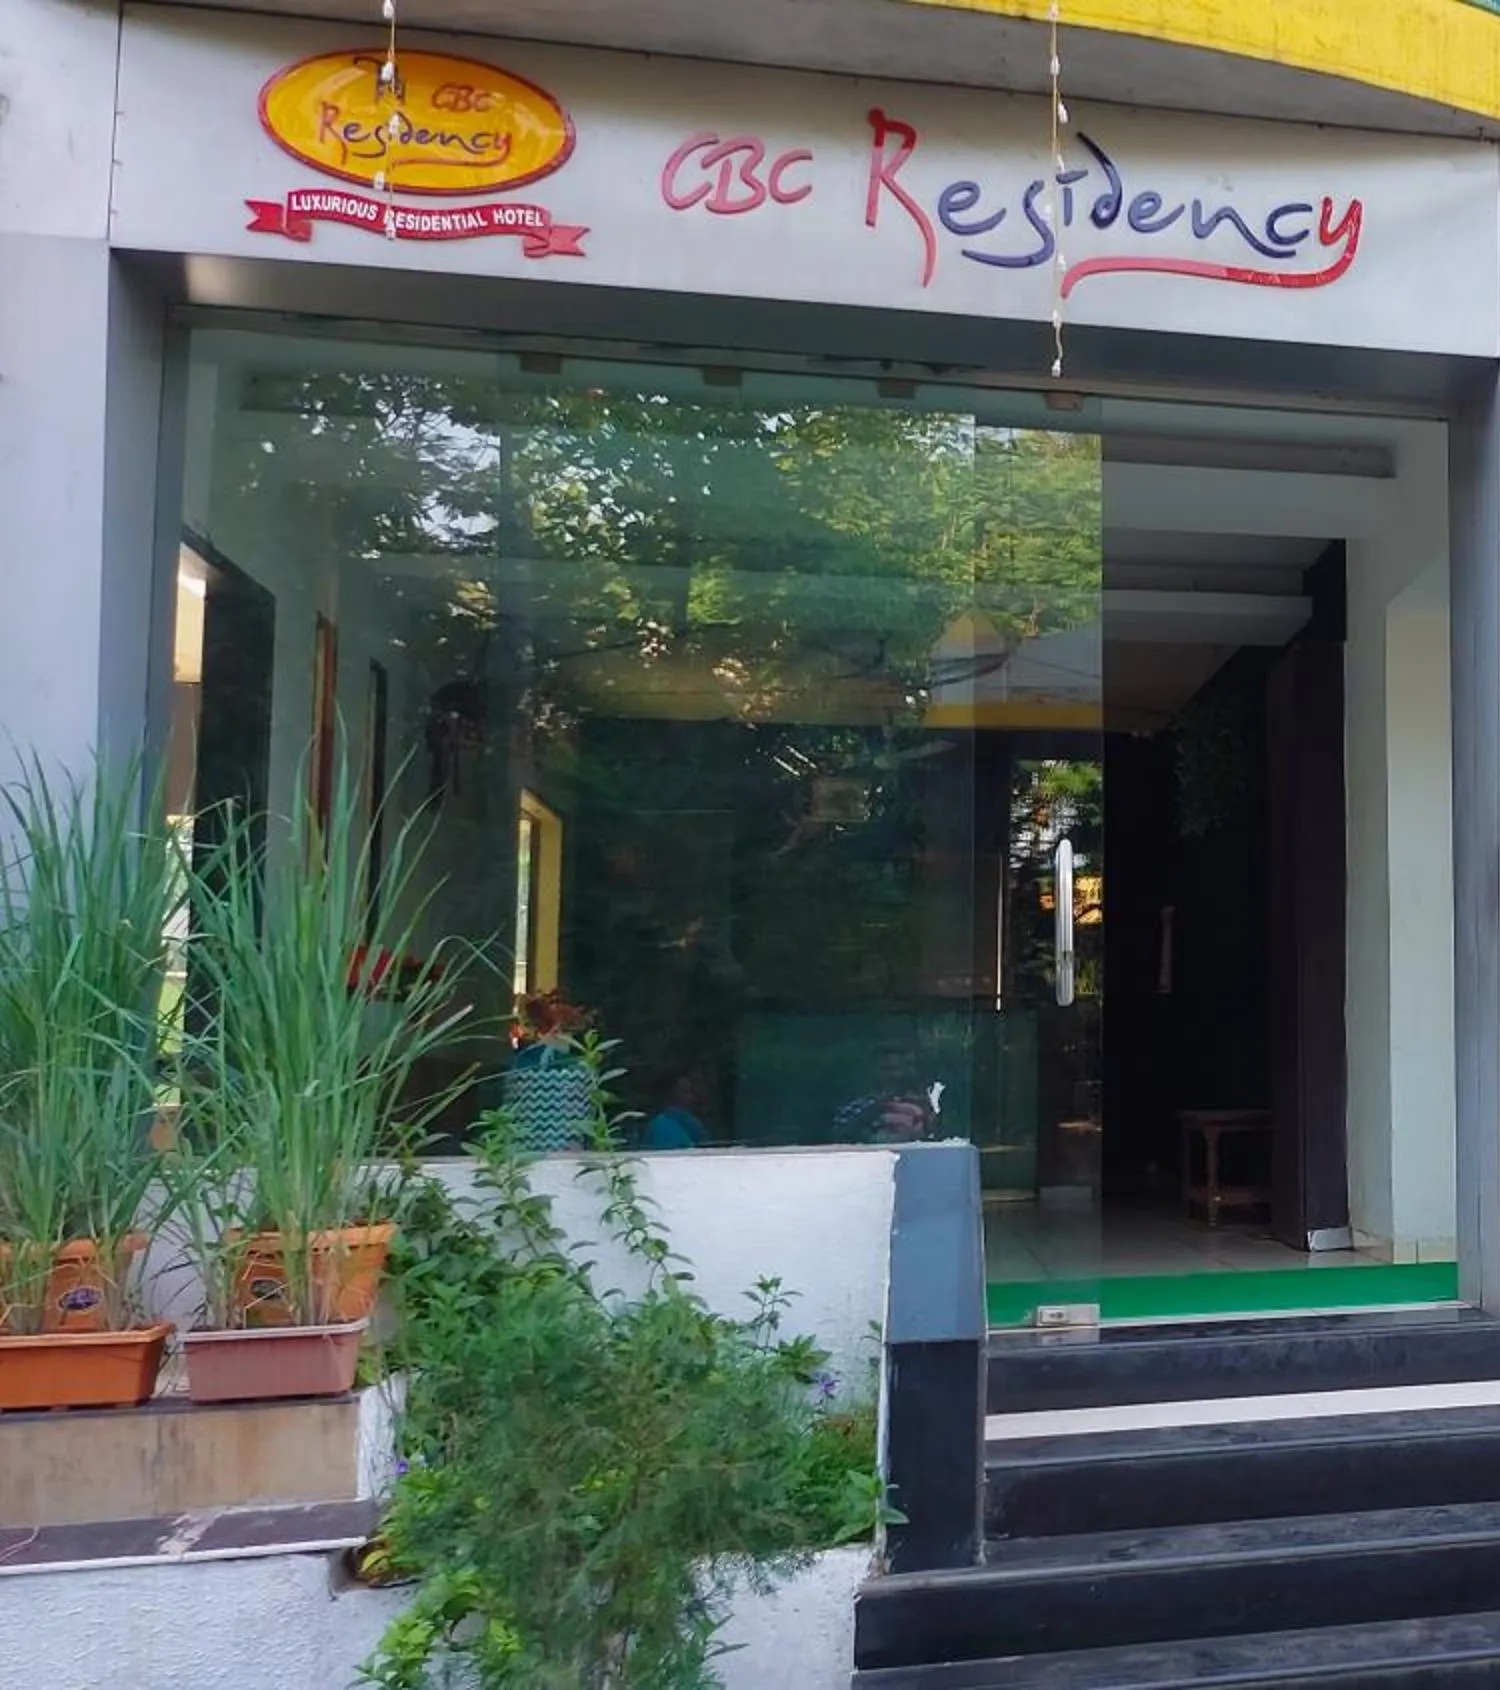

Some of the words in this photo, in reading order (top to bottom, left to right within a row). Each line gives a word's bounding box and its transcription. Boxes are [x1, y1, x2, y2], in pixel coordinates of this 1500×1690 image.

[291, 195, 378, 221] LUXURIOUS
[493, 208, 544, 227] HOTEL
[661, 132, 812, 214] CBC
[865, 107, 1362, 298] Residency
